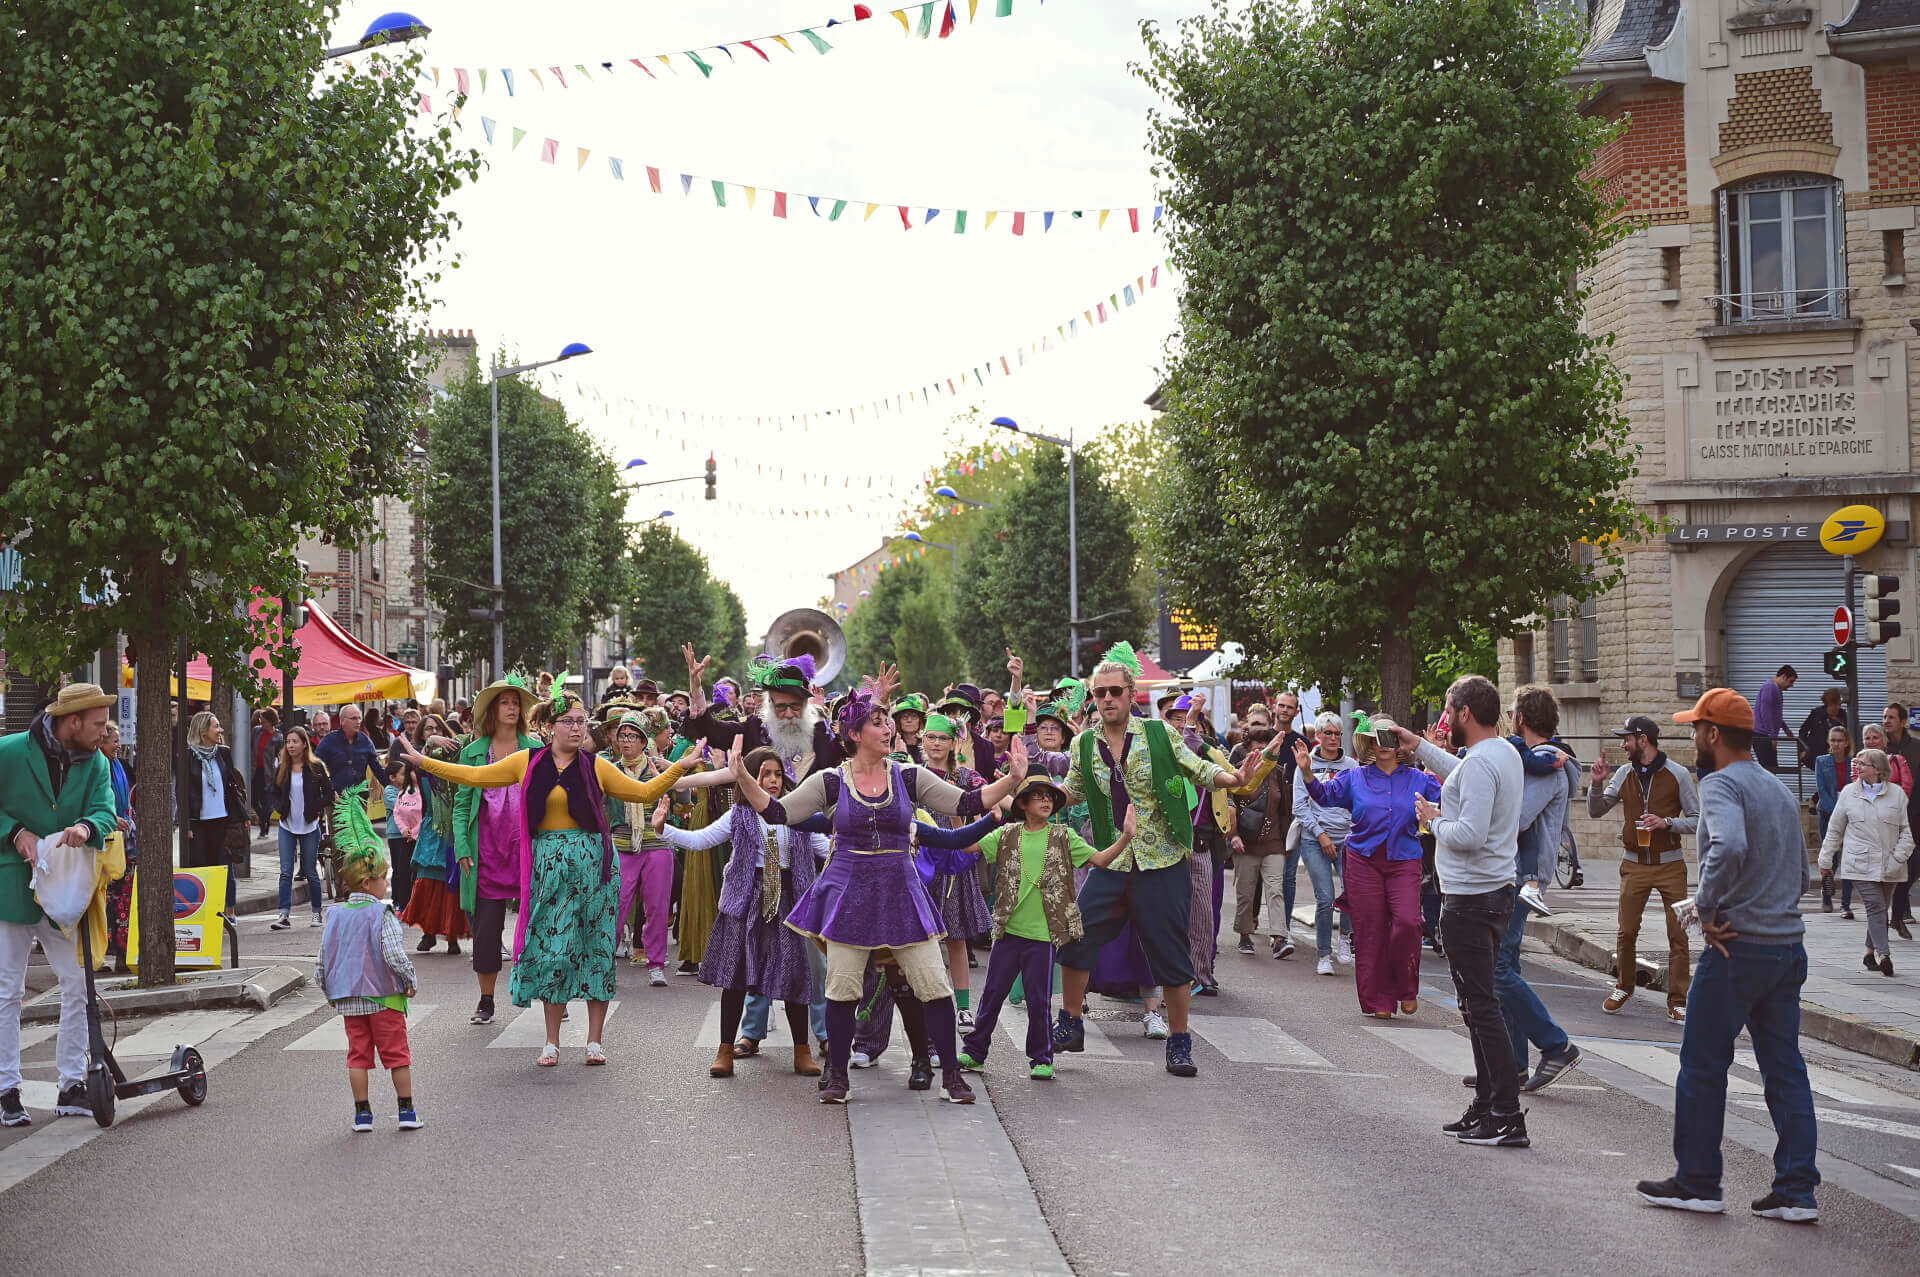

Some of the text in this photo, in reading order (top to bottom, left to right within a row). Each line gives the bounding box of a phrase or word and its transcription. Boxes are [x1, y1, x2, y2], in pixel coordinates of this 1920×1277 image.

[1732, 365, 1840, 391] POSTES
[1701, 444, 1740, 459] CAISSE
[1744, 442, 1805, 458] NATIONALE
[1680, 526, 1809, 539] LA POSTE
